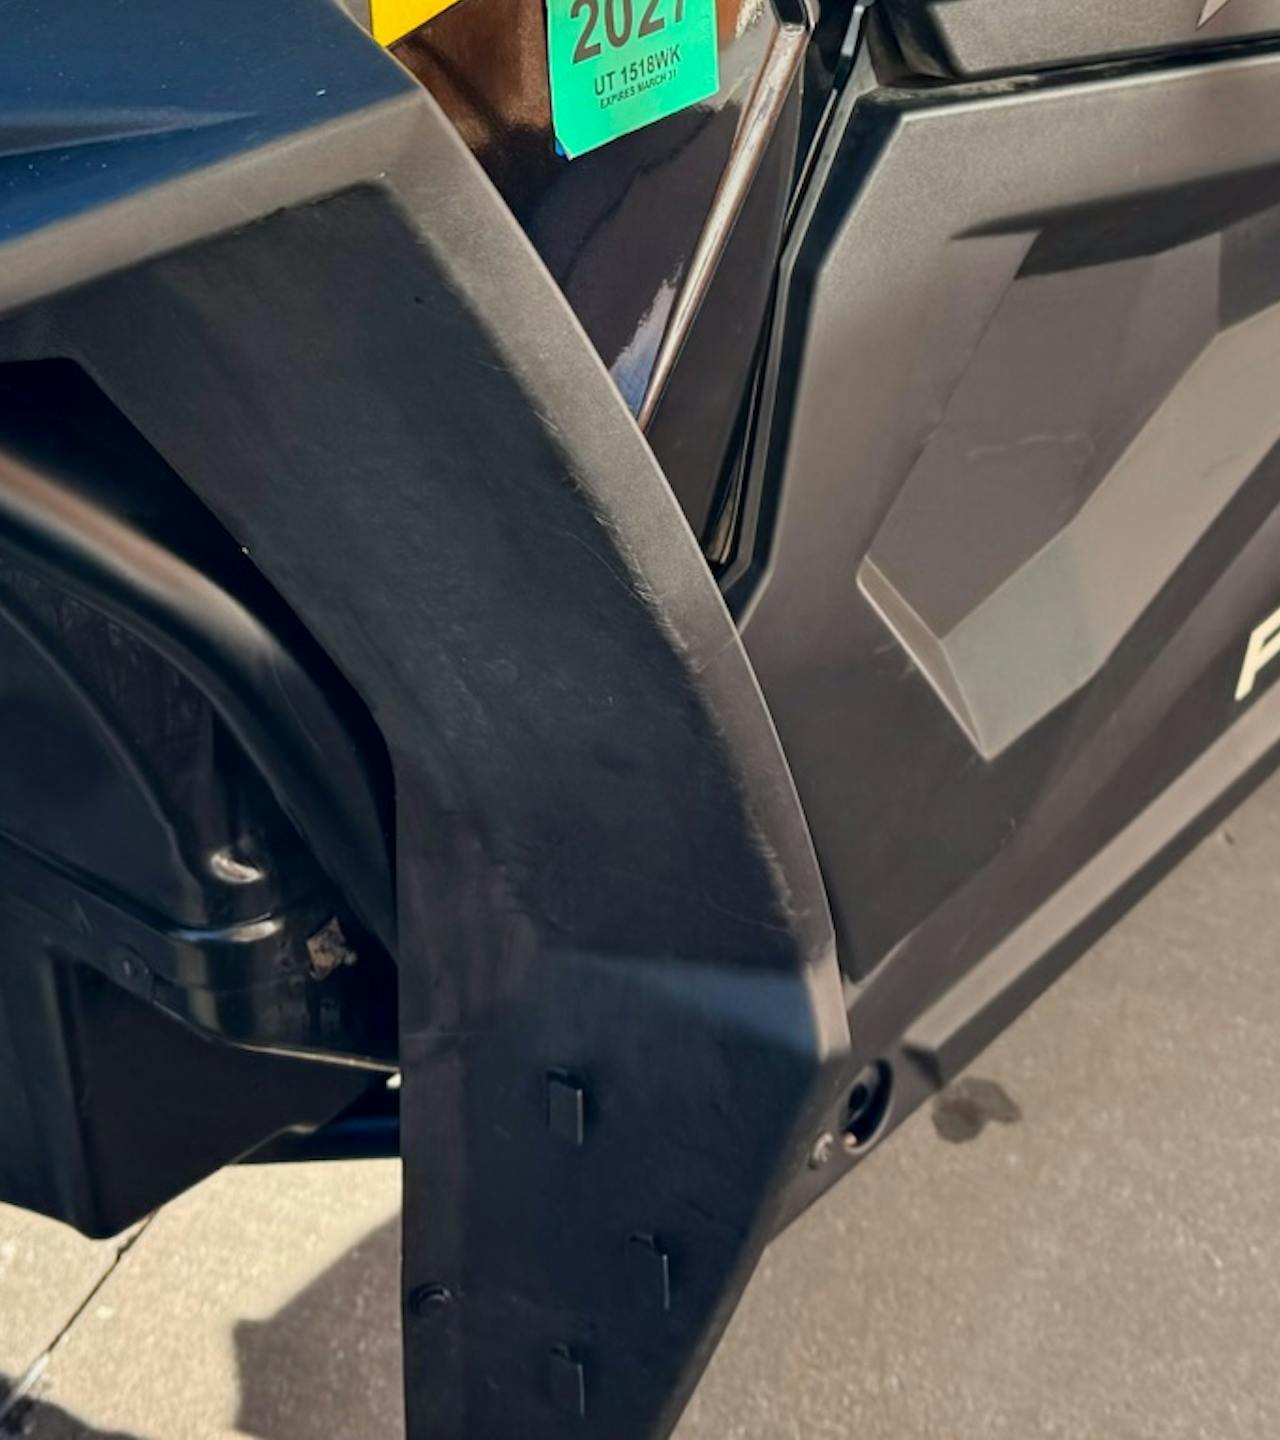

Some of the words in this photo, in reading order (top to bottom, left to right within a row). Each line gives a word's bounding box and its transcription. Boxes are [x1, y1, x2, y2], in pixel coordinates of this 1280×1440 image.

[594, 70, 616, 96] UT
[621, 44, 681, 85] 1518WK
[600, 86, 636, 110] EXPIRES
[637, 73, 667, 93] MARCH
